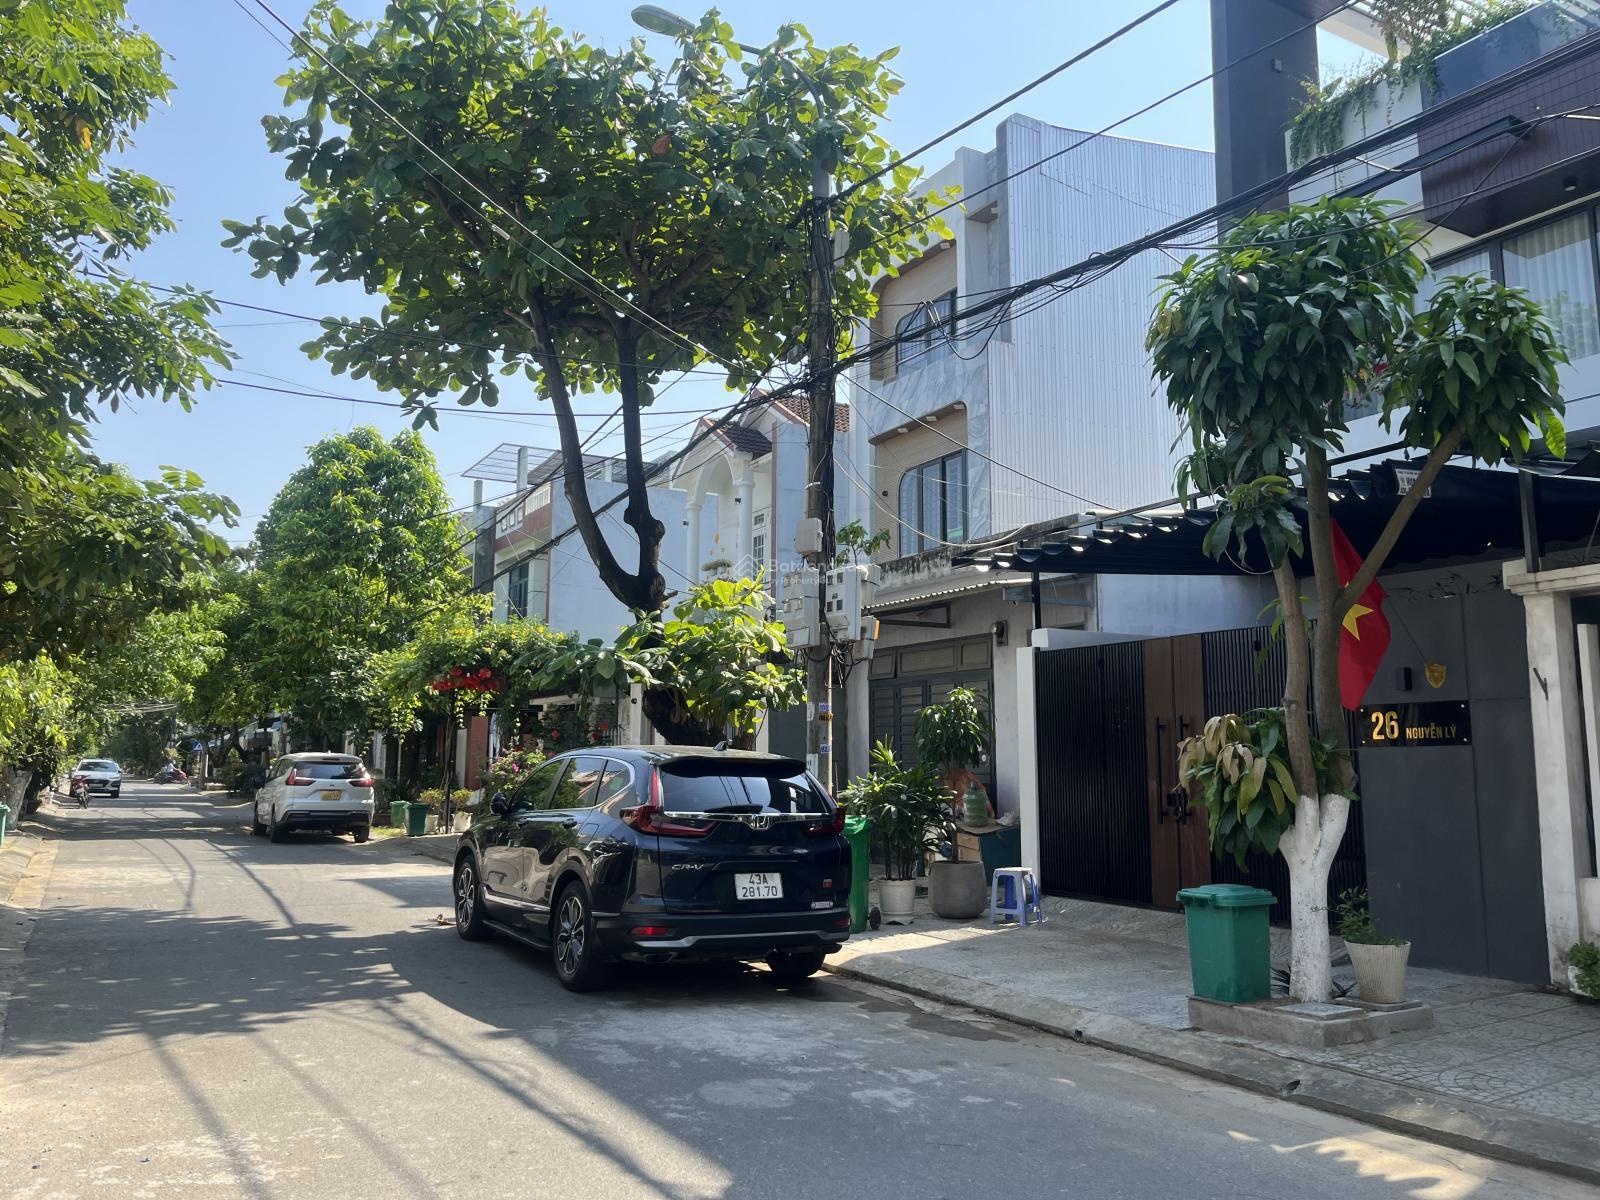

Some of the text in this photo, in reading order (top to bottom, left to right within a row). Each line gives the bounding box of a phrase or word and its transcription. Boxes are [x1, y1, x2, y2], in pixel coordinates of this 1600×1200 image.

[1371, 711, 1457, 740] 26 NGUYỄN LÝ
[748, 873, 769, 885] 43A
[741, 886, 778, 898] 281.70
